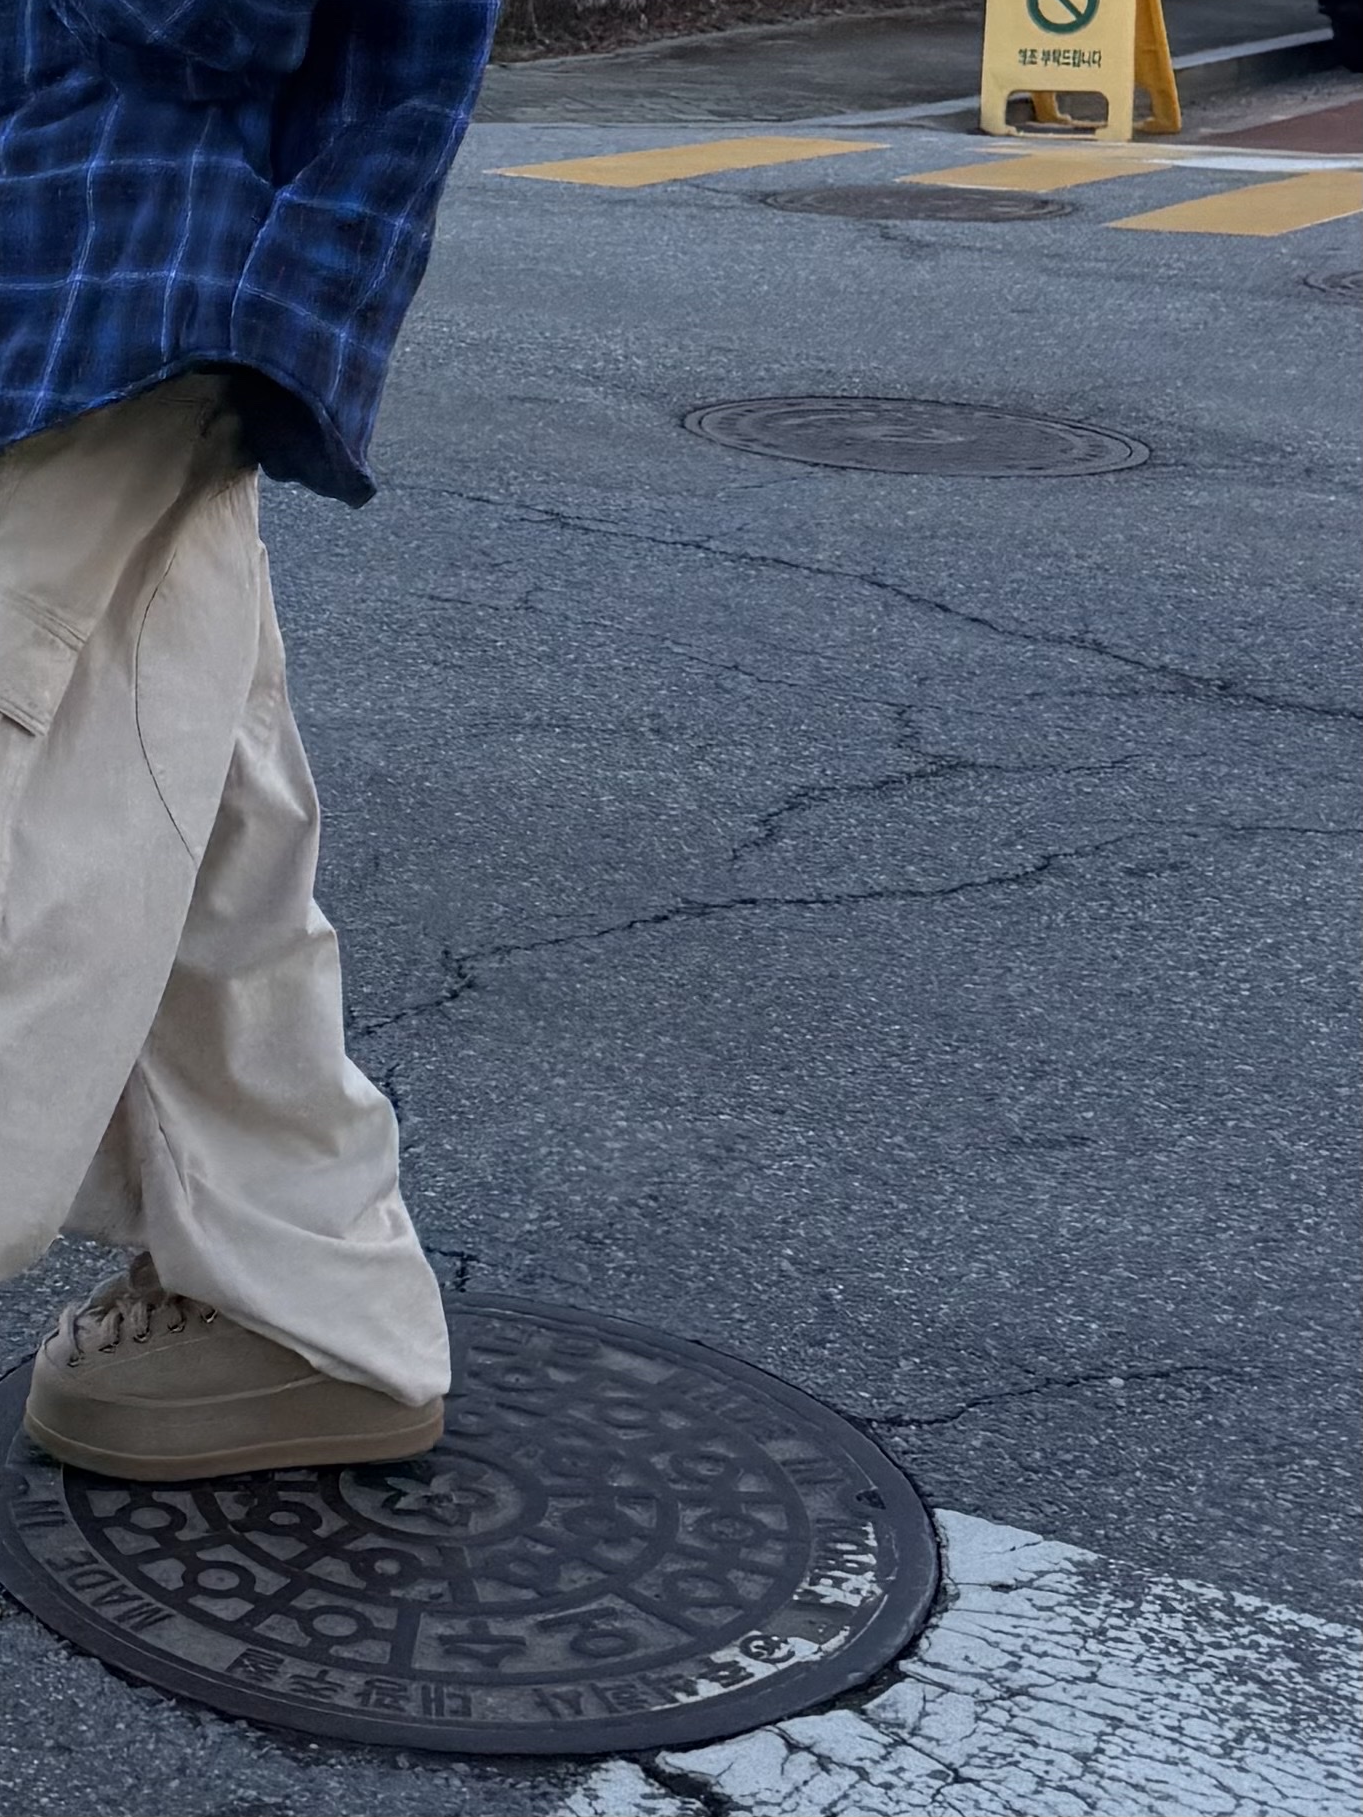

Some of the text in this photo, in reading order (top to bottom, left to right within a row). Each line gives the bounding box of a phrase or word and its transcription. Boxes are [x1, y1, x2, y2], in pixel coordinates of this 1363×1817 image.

[1041, 48, 1102, 68] 부탁드립니다
[14, 1499, 176, 1631] MADE IN
[439, 1605, 640, 1669] 오수
